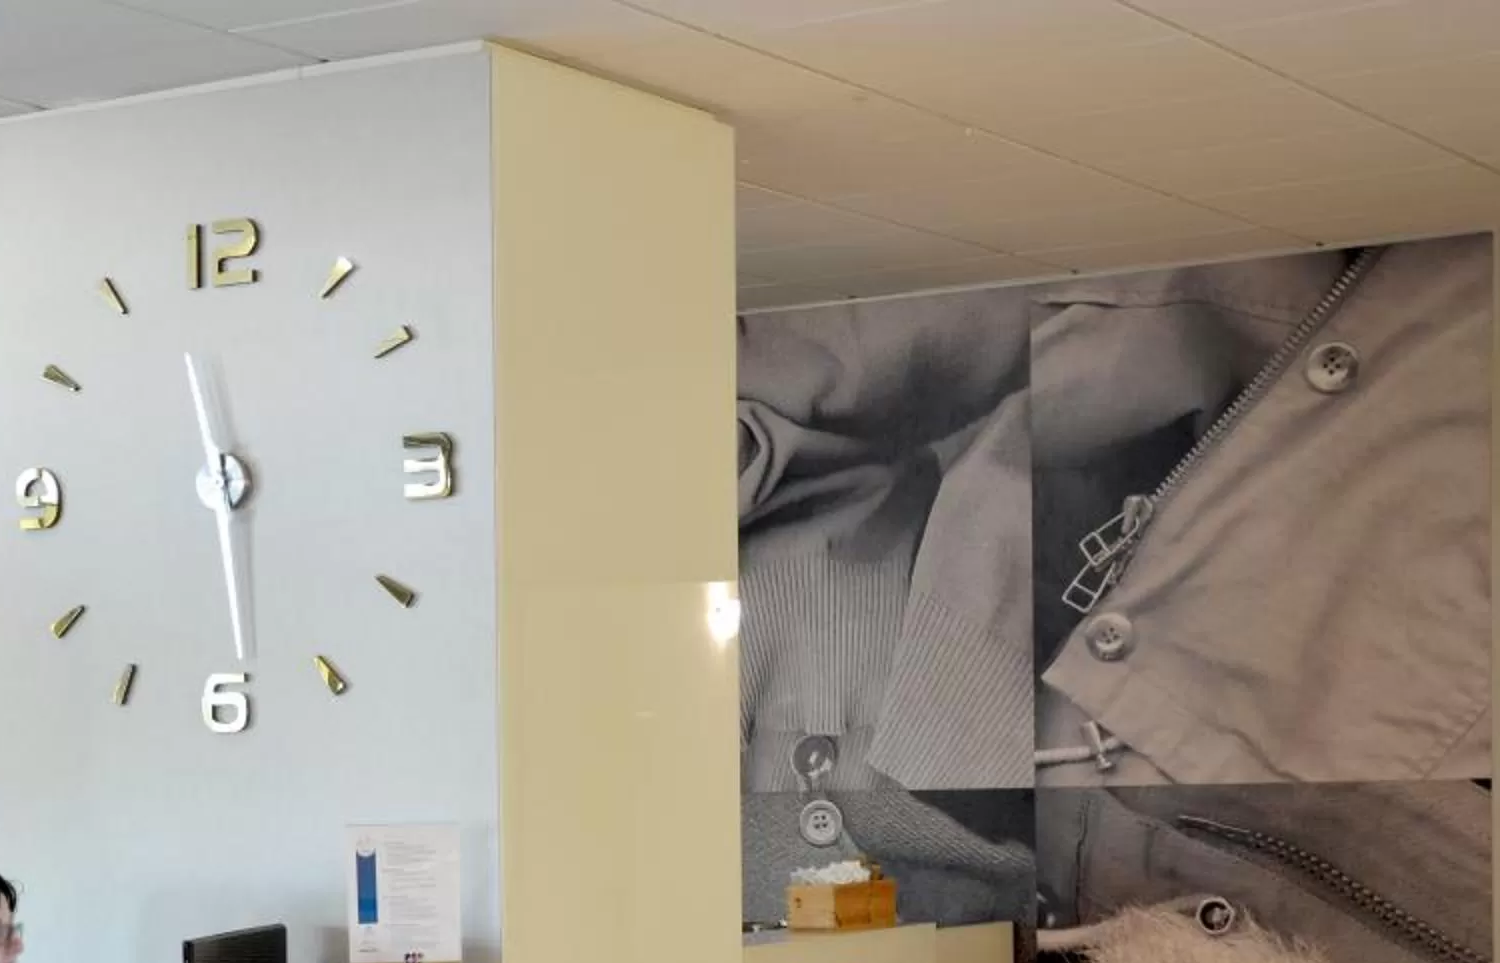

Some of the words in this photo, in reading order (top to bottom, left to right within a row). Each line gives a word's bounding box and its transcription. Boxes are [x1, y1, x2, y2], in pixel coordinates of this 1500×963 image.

[186, 218, 260, 289] 12
[403, 432, 453, 499] 3
[16, 467, 62, 530] 9
[201, 672, 251, 733] 6
